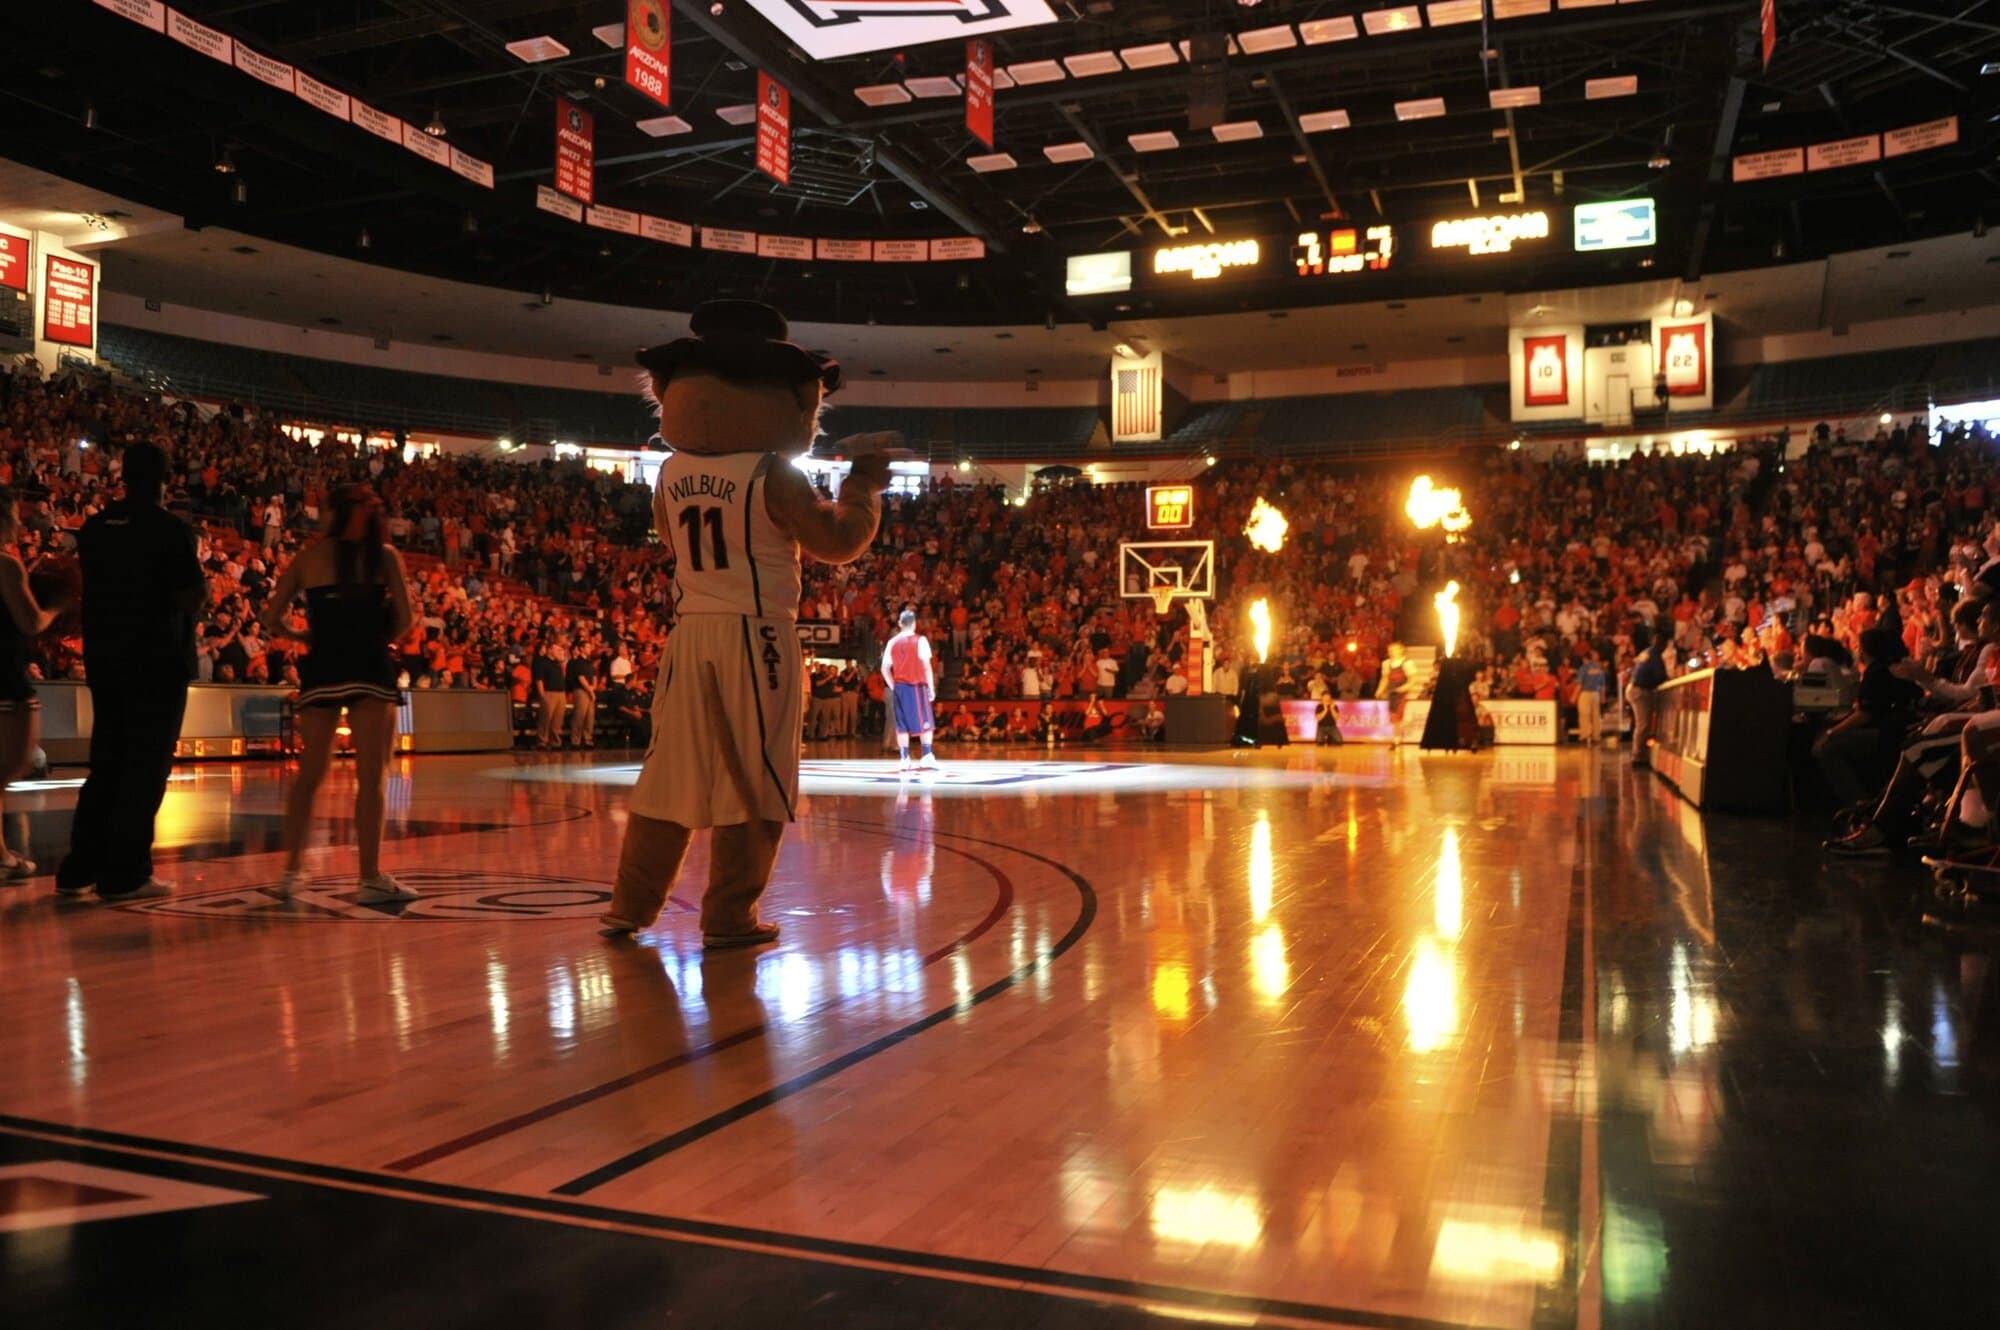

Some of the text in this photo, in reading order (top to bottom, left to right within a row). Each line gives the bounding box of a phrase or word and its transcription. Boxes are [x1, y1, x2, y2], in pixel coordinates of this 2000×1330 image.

[629, 45, 669, 78] ARIZONA
[634, 67, 662, 96] 1988
[558, 127, 592, 152] ARIZONA
[1537, 365, 1553, 378] 10
[1672, 354, 1693, 368] 22
[668, 474, 736, 504] WILBUR
[1157, 505, 1183, 524] 00
[679, 505, 730, 572] 11
[759, 625, 781, 690] CATS
